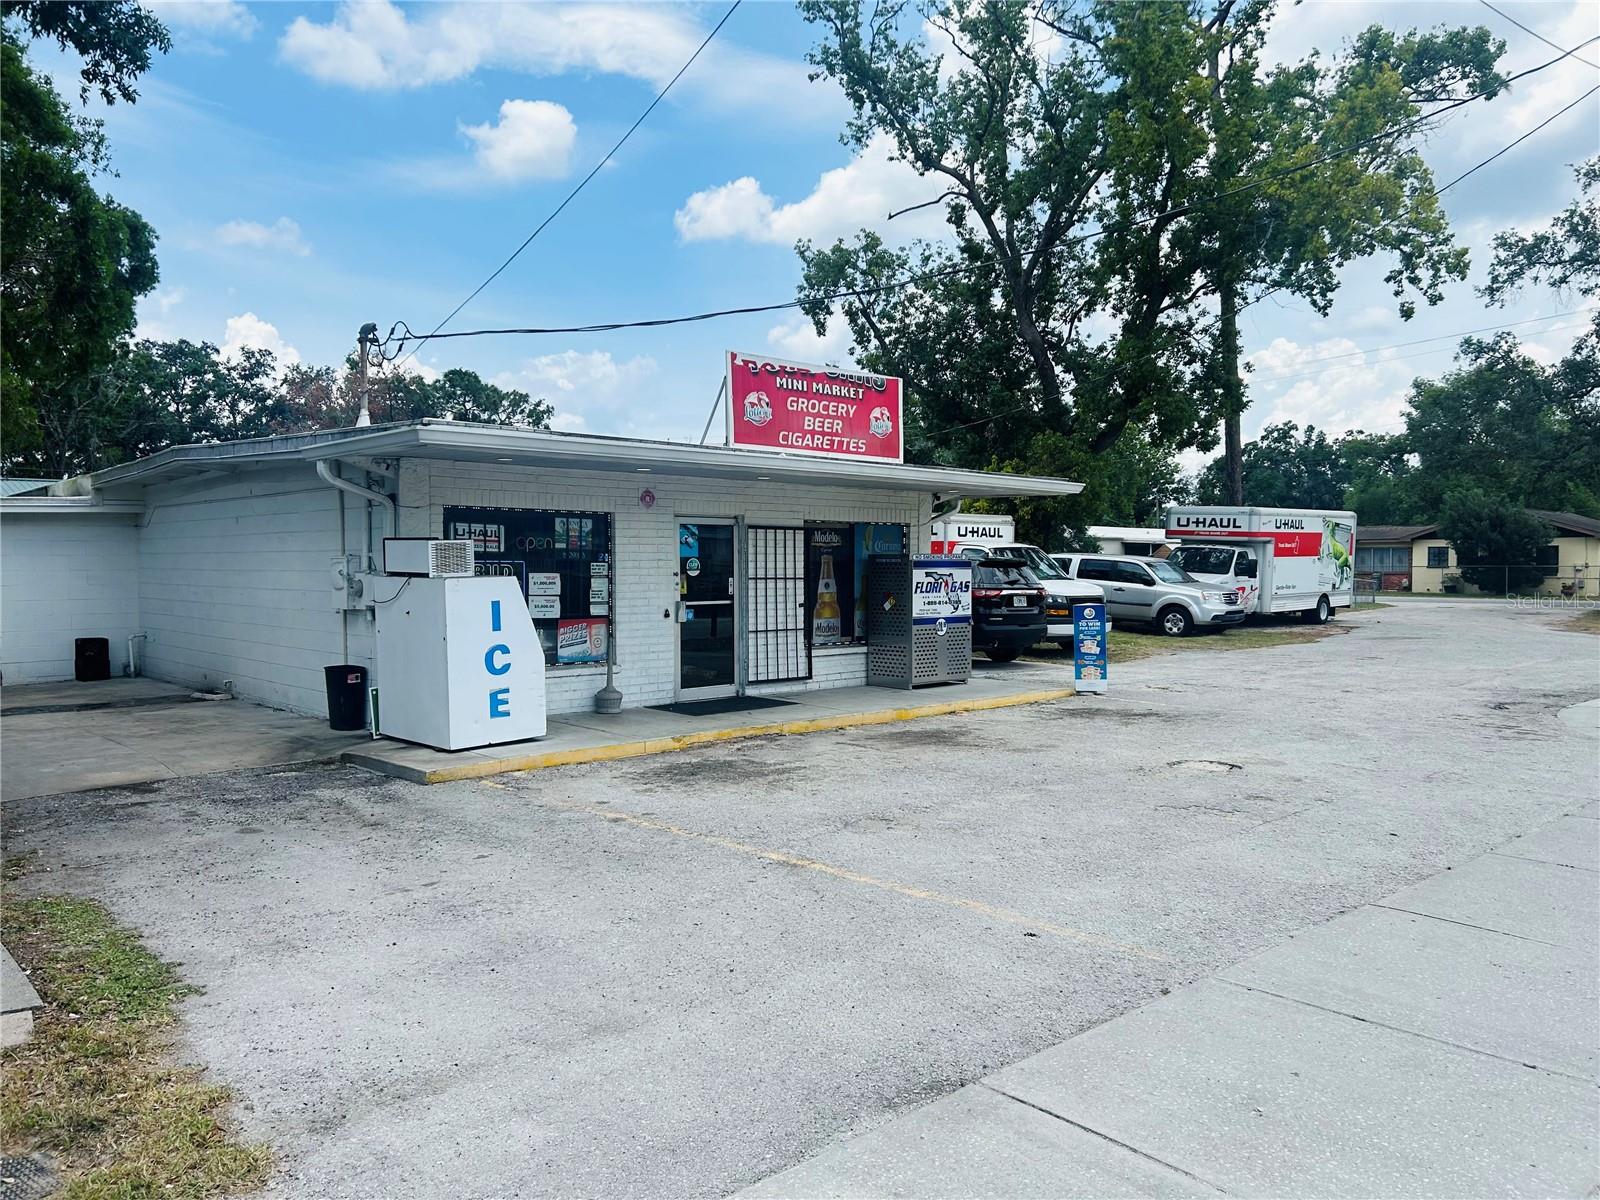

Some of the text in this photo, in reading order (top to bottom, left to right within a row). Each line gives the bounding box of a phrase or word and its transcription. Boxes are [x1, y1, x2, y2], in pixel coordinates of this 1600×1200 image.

[776, 377, 807, 391] MINI
[812, 382, 864, 399] MARKET
[787, 397, 856, 418] GROCERY
[804, 416, 842, 433] BEER
[779, 431, 867, 452] CIGARETTES
[1177, 517, 1241, 528] U-HAUL
[1275, 519, 1304, 529] U-HAUL
[814, 530, 838, 543] Modelo
[957, 526, 1003, 537] U-HAUL
[516, 536, 553, 552] open
[914, 581, 970, 594] FLORI GAS
[559, 622, 587, 634] BIGGER
[815, 622, 839, 633] Modelo
[559, 630, 588, 644] PRIZES
